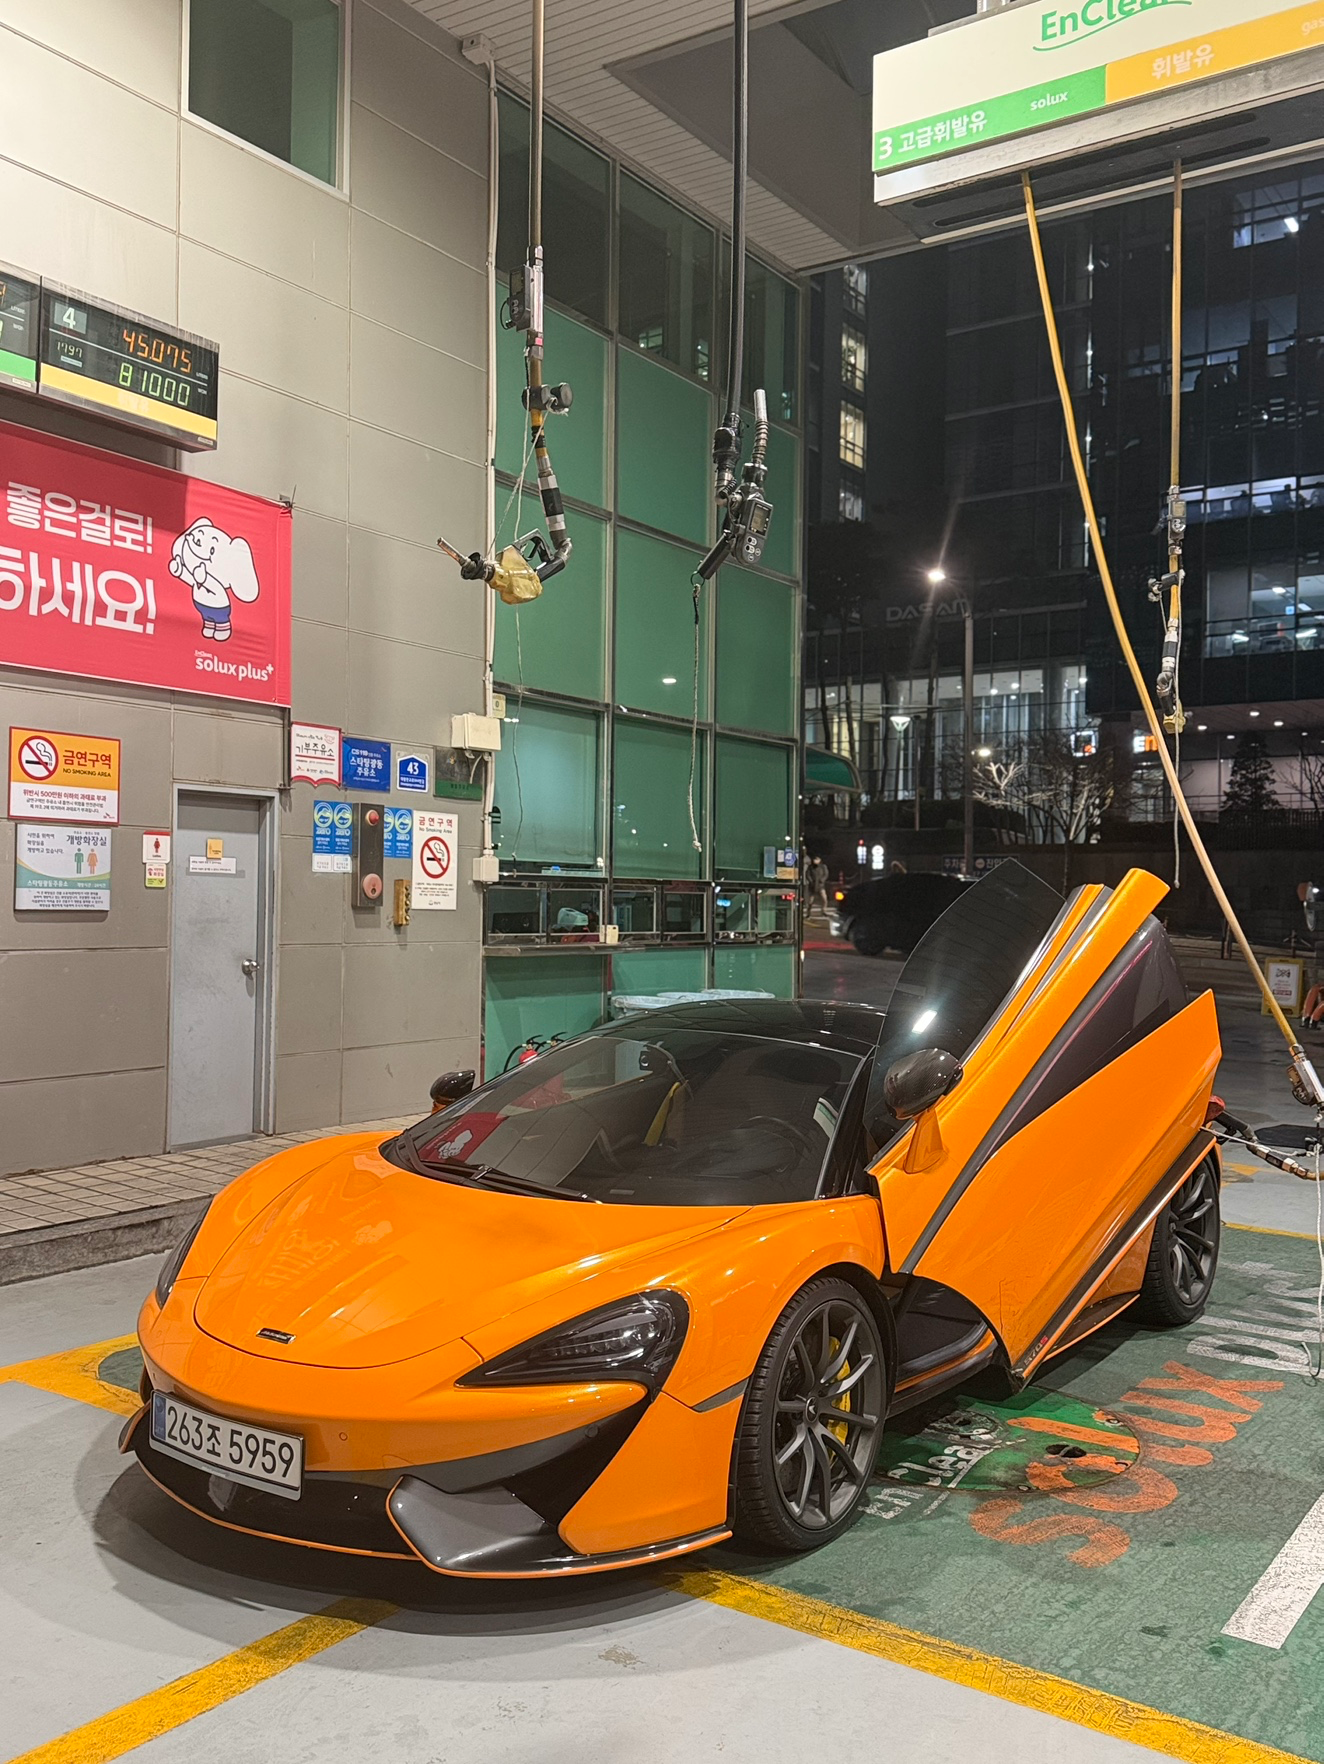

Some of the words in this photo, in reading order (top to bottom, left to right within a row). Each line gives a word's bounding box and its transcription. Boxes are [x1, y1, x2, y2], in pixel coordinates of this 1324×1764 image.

[1151, 43, 1215, 80] 휘발유
[1030, 91, 1068, 111] solux
[879, 136, 893, 160] 3
[898, 110, 988, 153] 고급휘발유
[62, 306, 76, 329] 4
[6, 481, 153, 555] 좋은걸로!
[195, 655, 237, 676] solux
[63, 750, 111, 769] 금연구역
[296, 742, 334, 757] 기부주유소
[356, 767, 376, 777] 주유소
[407, 761, 419, 775] 43
[66, 835, 107, 846] 개방화장실
[167, 1406, 221, 1457] 263조
[229, 1429, 294, 1478] 5959
[969, 1361, 1284, 1568] solux
